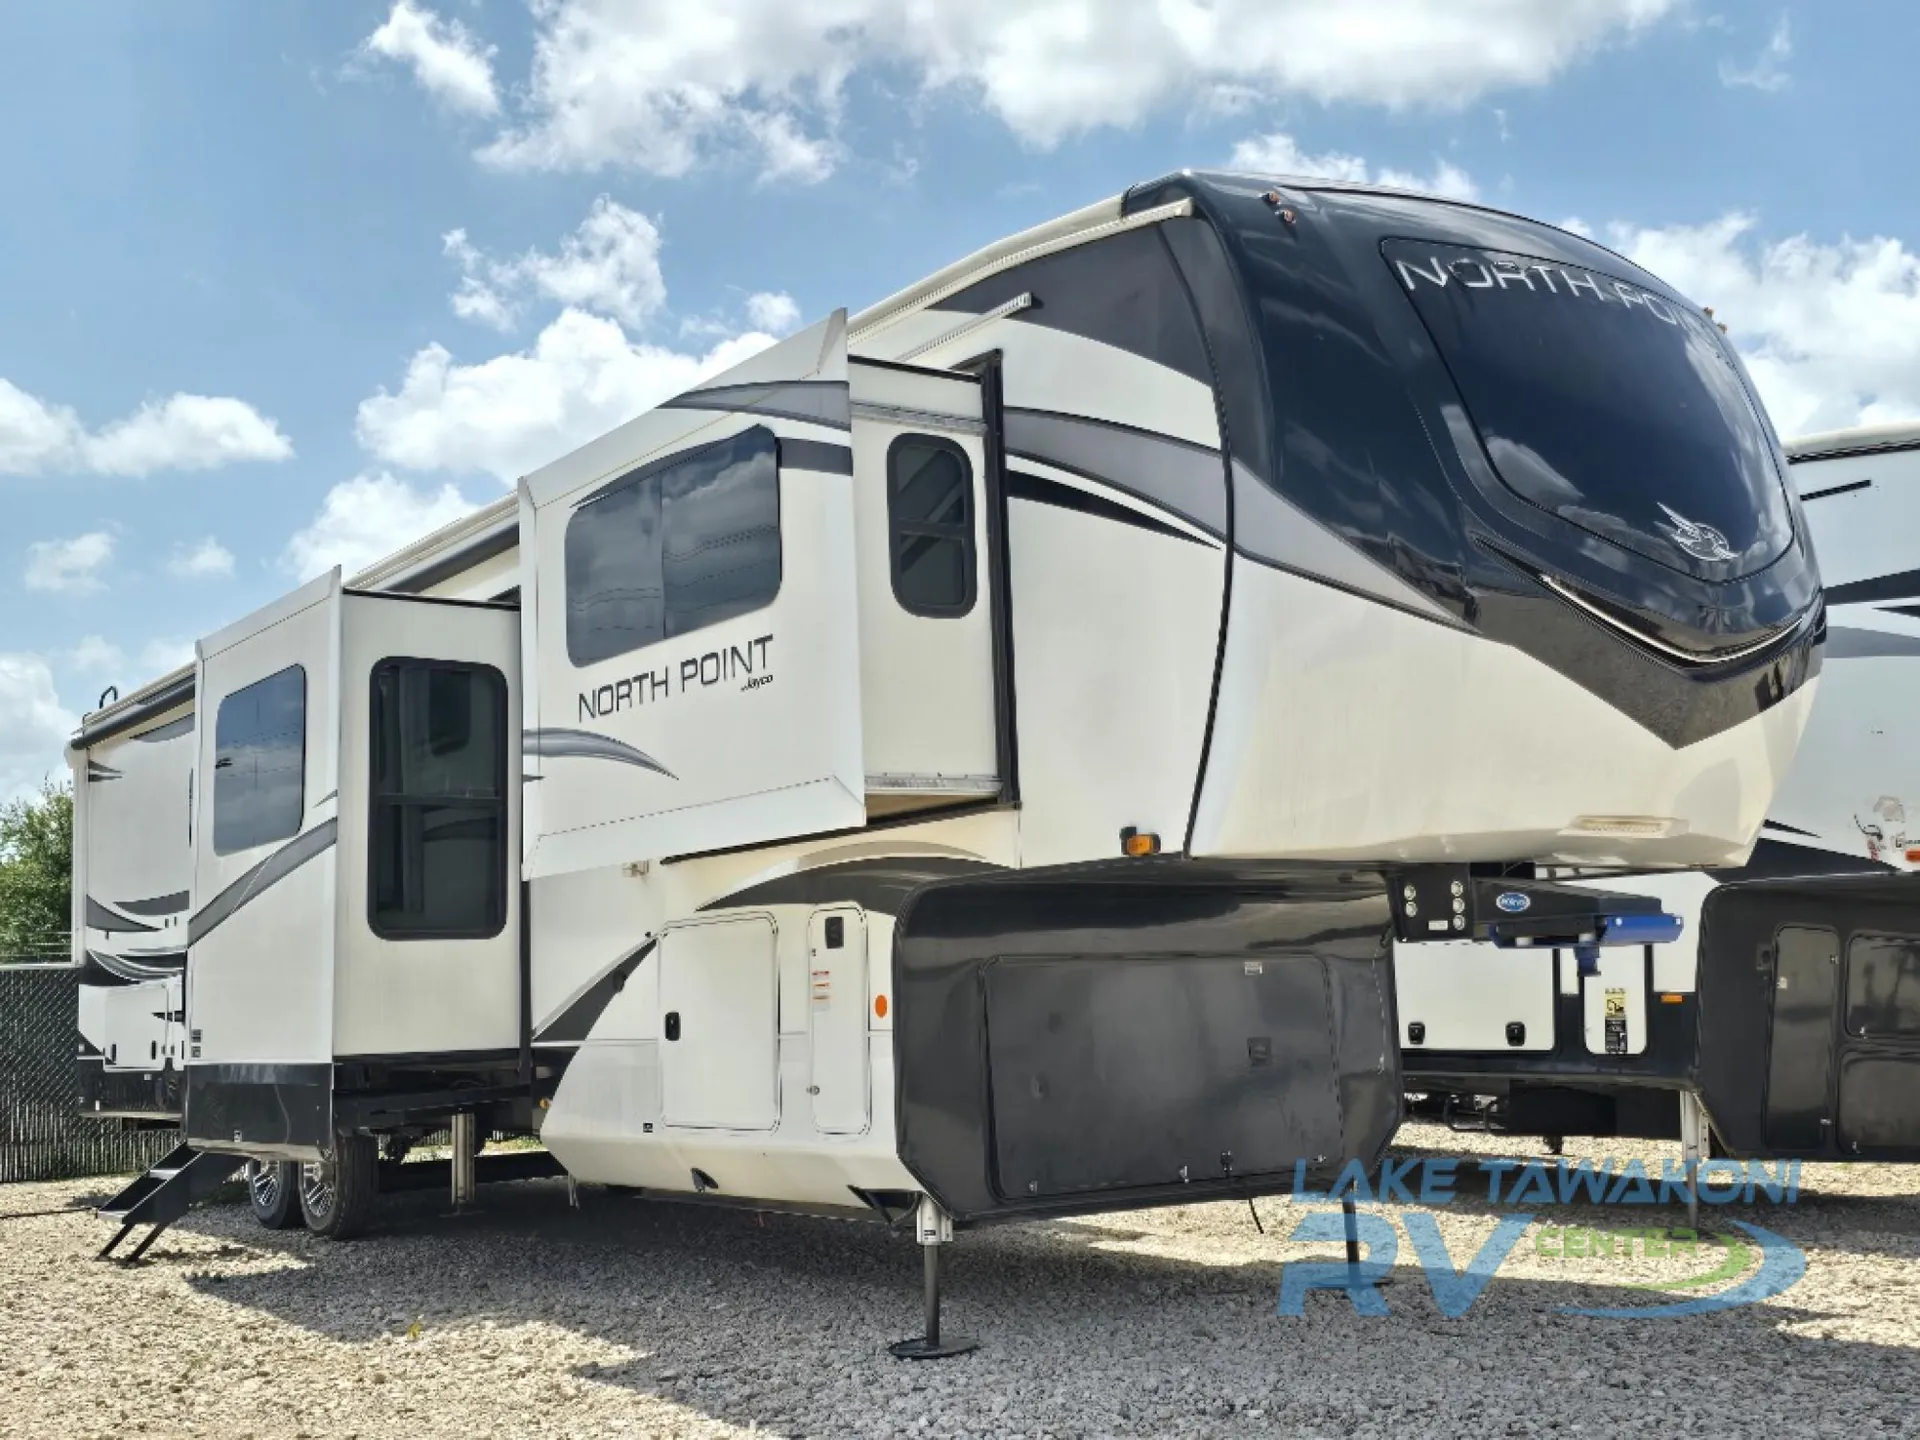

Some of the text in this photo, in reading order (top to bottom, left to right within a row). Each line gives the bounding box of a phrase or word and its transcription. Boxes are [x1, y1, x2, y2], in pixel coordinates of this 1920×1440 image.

[1396, 257, 1604, 301] NORTH
[578, 634, 774, 722] NORTH POINT
